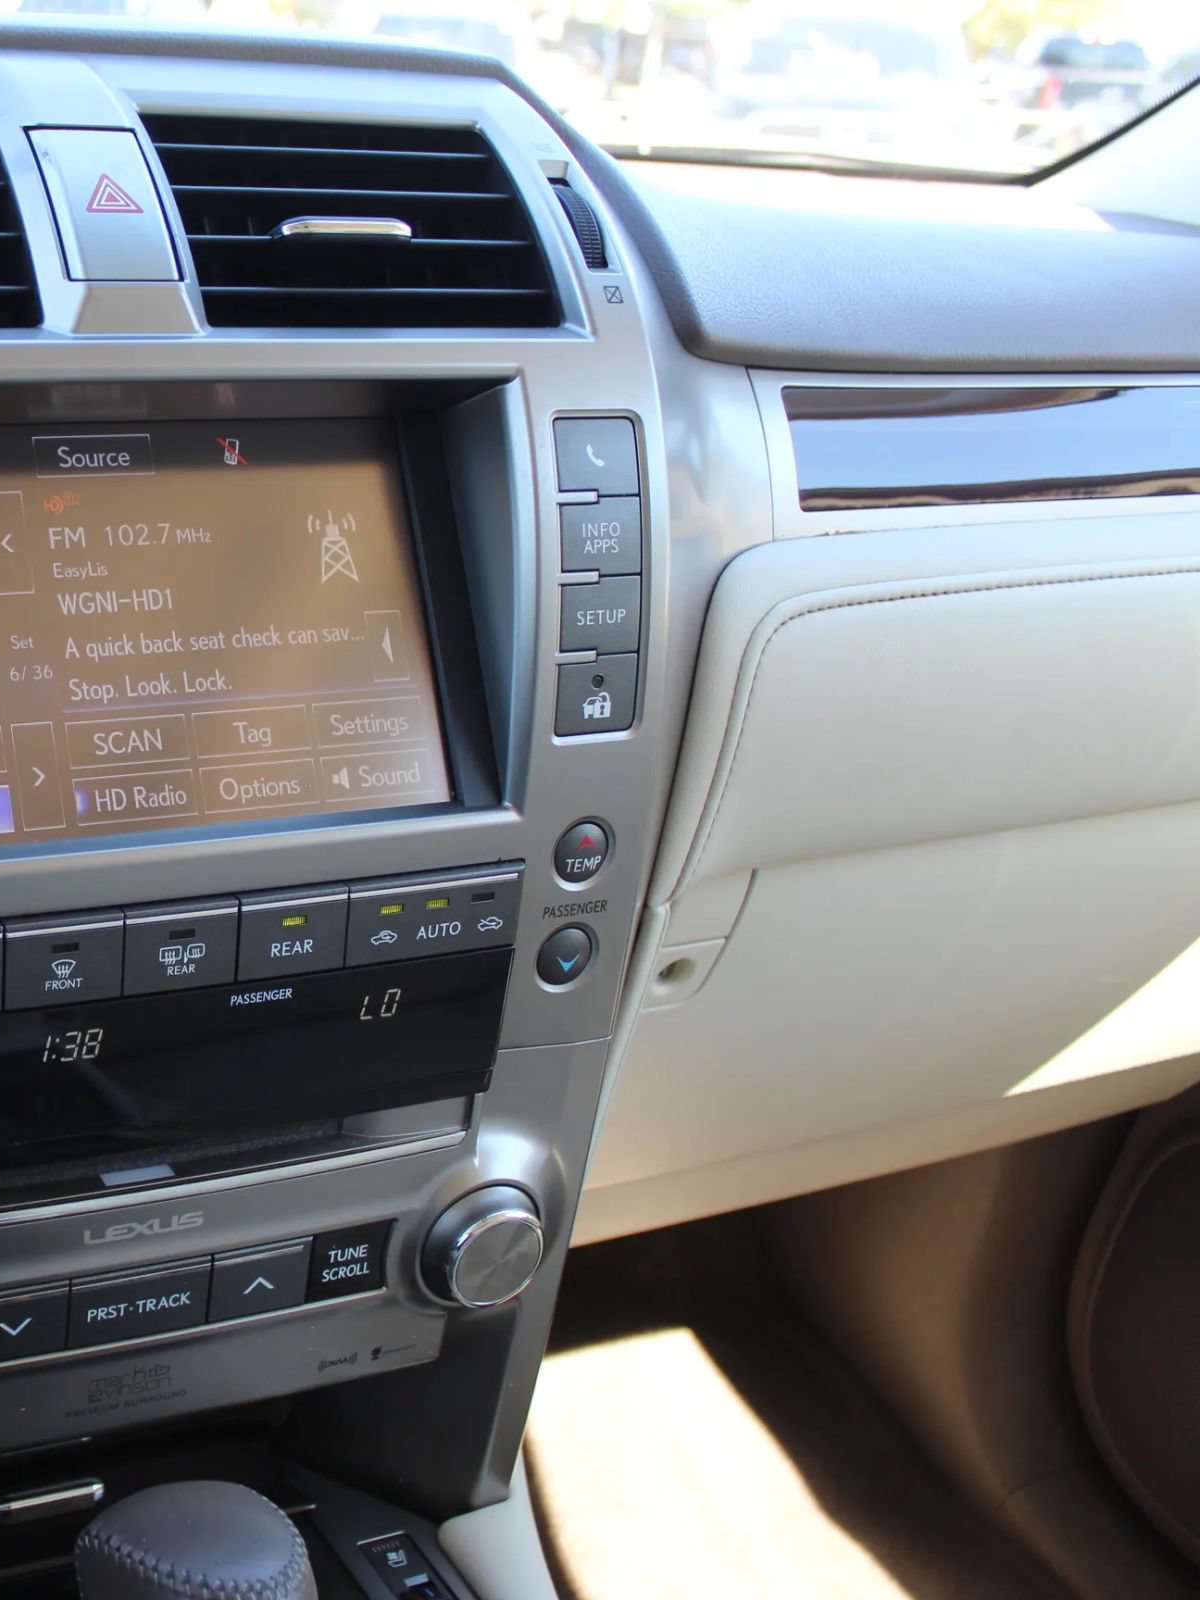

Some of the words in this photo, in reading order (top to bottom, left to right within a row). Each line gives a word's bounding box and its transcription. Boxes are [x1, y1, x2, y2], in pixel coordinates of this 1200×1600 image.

[57, 446, 131, 469] Source
[48, 527, 86, 549] FM
[104, 523, 170, 546] 102.7
[176, 528, 212, 544] MHz
[581, 523, 620, 537] INFO
[584, 538, 619, 554] APPS
[53, 561, 108, 580] EasyLis
[57, 588, 173, 615] WGNI-HD1
[577, 609, 626, 626] SETUP
[10, 636, 34, 650] Set
[65, 637, 80, 659] A
[87, 634, 135, 662] quick
[141, 631, 184, 654] back
[190, 632, 225, 651] seat
[232, 625, 281, 648] check
[288, 628, 317, 644] can
[69, 679, 118, 703] Stop.
[125, 673, 177, 697] Look.
[183, 669, 233, 693] Lock.
[233, 722, 272, 746] Tag
[330, 713, 408, 737] Settings
[93, 728, 163, 755] SCAN
[358, 764, 421, 787] Sound
[95, 789, 126, 812] HD
[134, 784, 187, 808] Radio
[219, 778, 300, 804] Options
[566, 856, 601, 872] TEMP
[543, 900, 608, 919] PASSENGER
[417, 921, 461, 940] AUTO
[270, 939, 313, 957] REAR
[166, 963, 196, 976] REAR
[44, 978, 83, 990] FRONT
[230, 988, 292, 1006] PASSENGER
[42, 1028, 103, 1062] 1:38
[84, 1211, 204, 1245] LEXUS
[328, 1244, 368, 1262] TUNE
[321, 1262, 370, 1283] SCROLL
